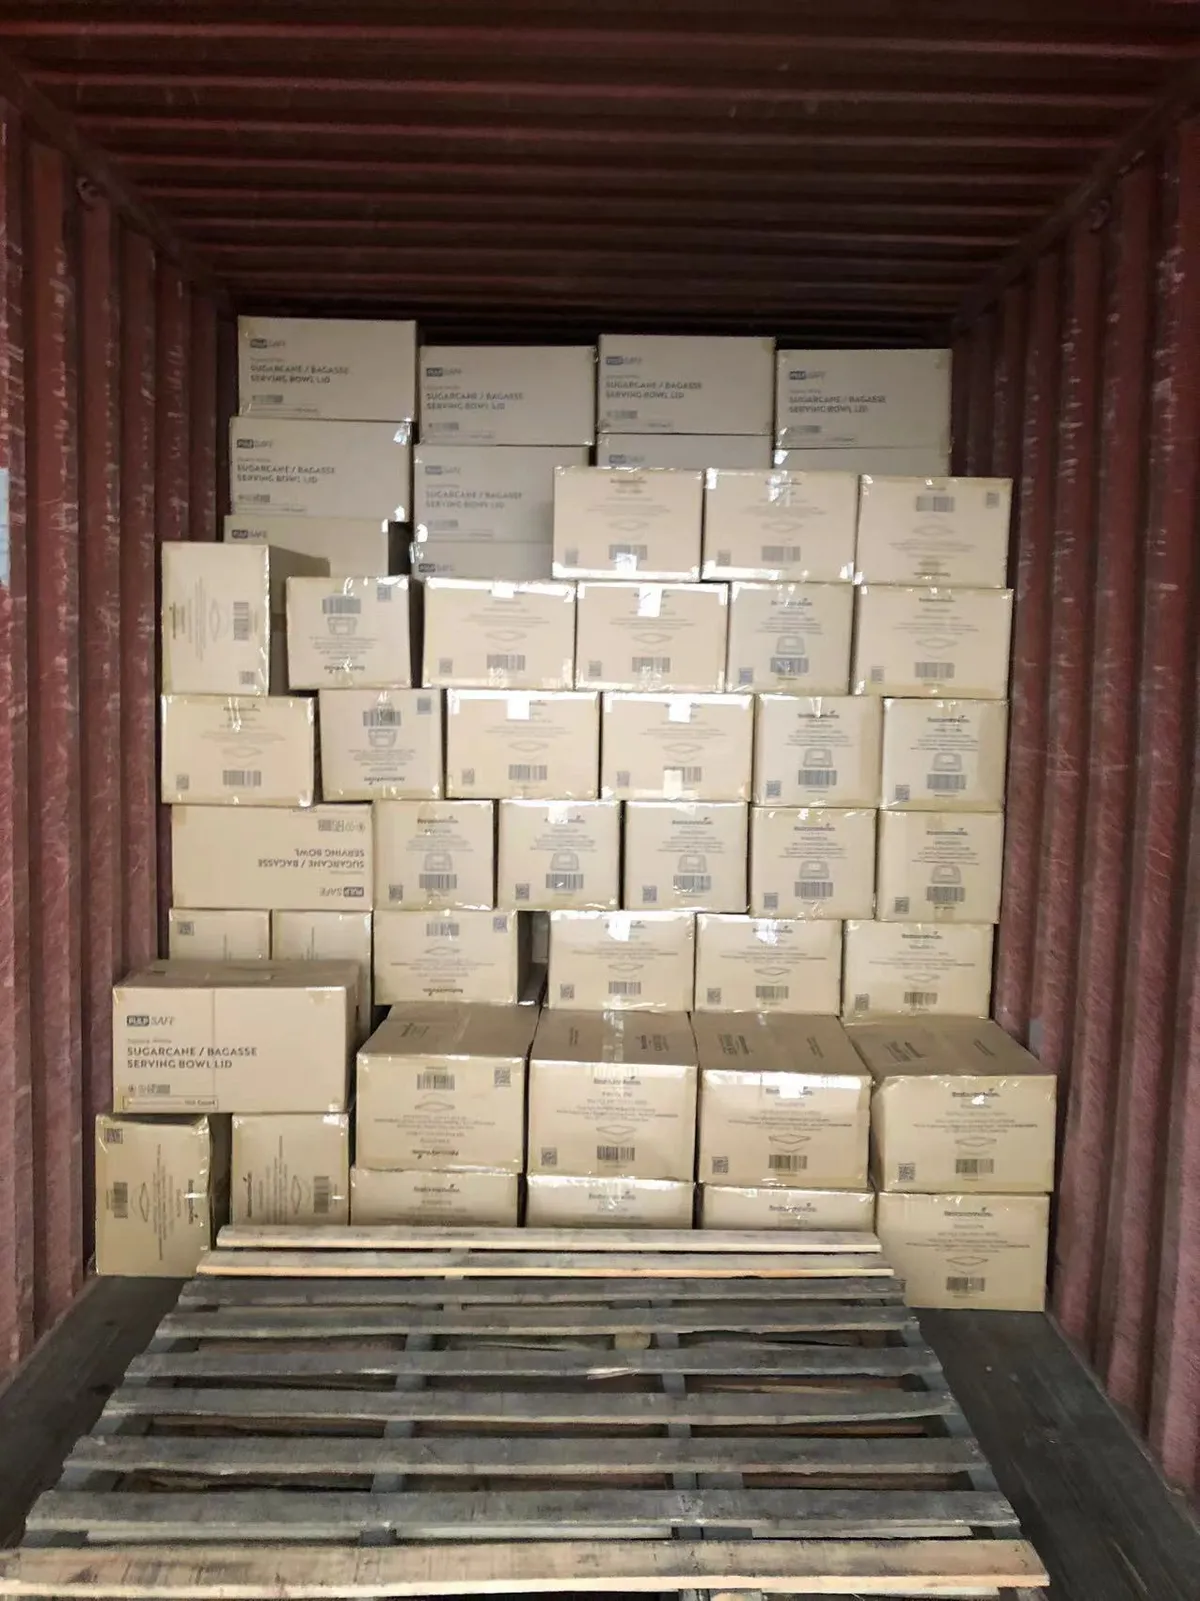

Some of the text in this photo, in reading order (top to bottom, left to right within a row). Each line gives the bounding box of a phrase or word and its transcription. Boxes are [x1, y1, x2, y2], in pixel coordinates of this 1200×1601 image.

[294, 848, 365, 857] SERVING BOWL
[258, 859, 299, 868] BAGASSE
[308, 860, 365, 868] SUGARCANE
[127, 1047, 196, 1056] SUGARCANE
[207, 1047, 258, 1057] BAGASSE
[127, 1060, 233, 1069] SERVING BOWL LID
